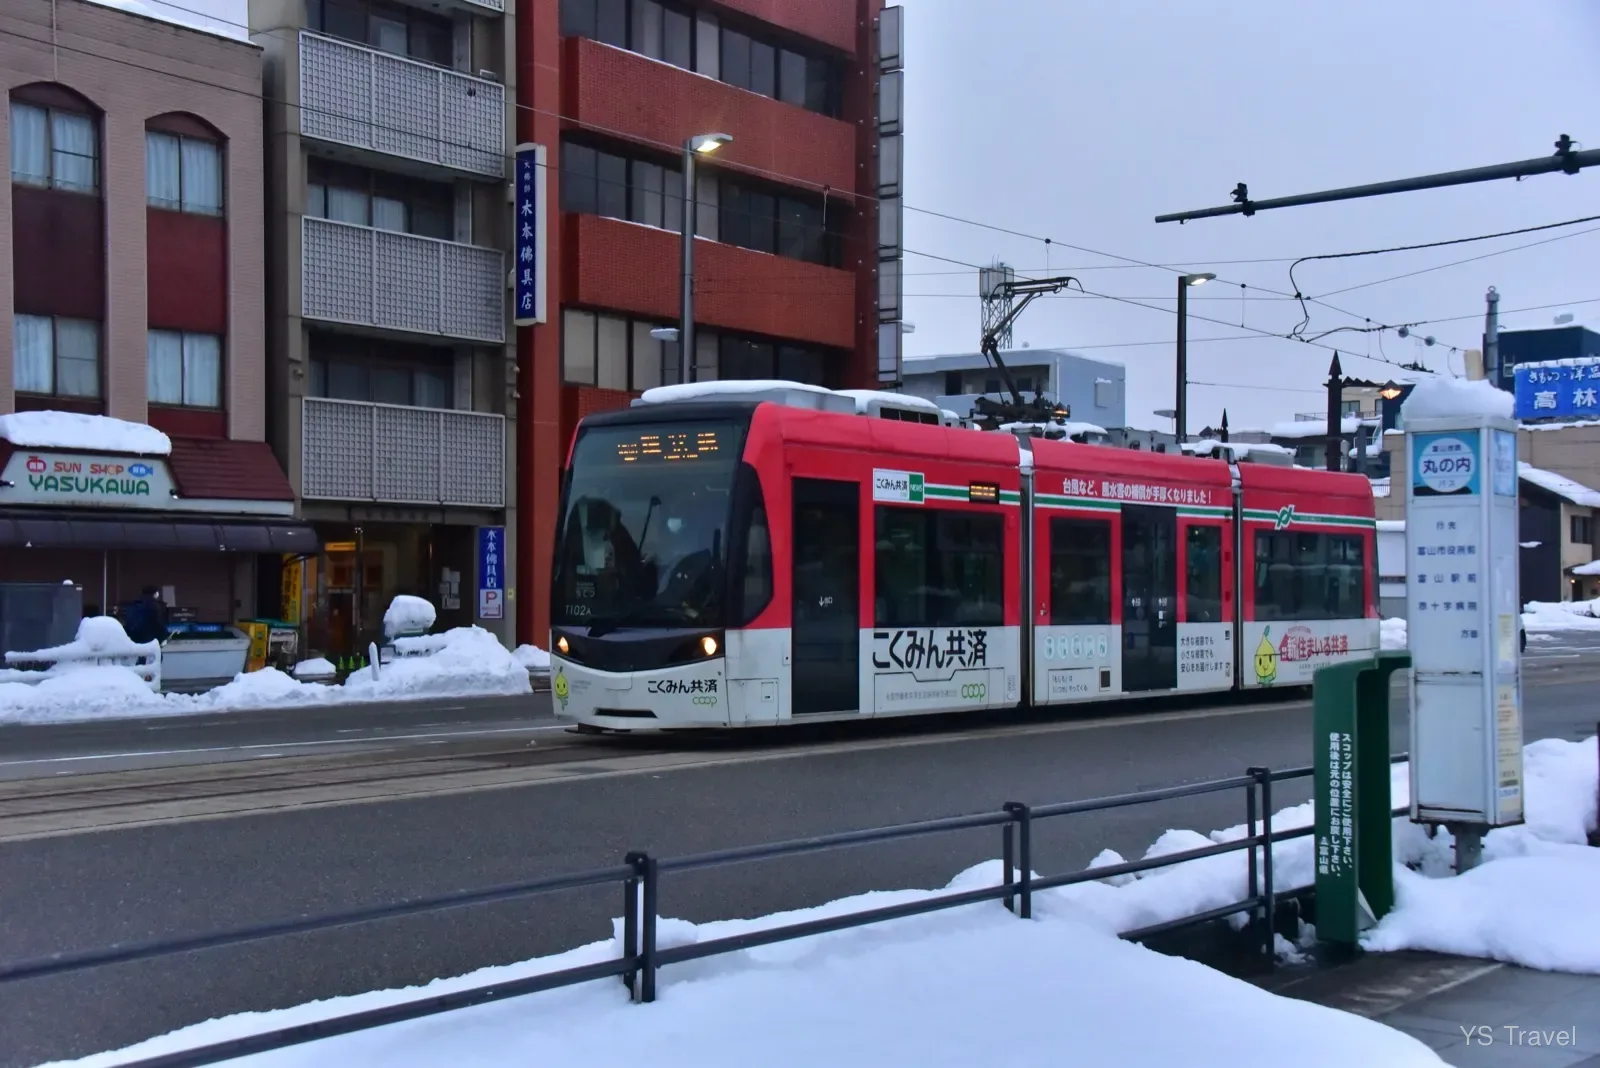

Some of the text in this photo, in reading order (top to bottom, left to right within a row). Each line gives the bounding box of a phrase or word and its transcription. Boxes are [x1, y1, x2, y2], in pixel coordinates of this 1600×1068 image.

[520, 199, 533, 310] 木本佛具店
[1534, 388, 1597, 409] 高林
[54, 462, 82, 473] SUN
[90, 464, 124, 475] SHOP
[1423, 457, 1471, 473] 丸の内
[28, 474, 150, 495] YASUKAWA
[876, 478, 908, 490] こくみん共済
[1417, 545, 1476, 556] 富山市役所前
[1417, 573, 1477, 584] 富山駅前
[486, 591, 497, 604] P
[1418, 601, 1478, 612] 赤十字病院
[872, 629, 987, 670] こくみん共済
[647, 679, 718, 694] こくみん共済
